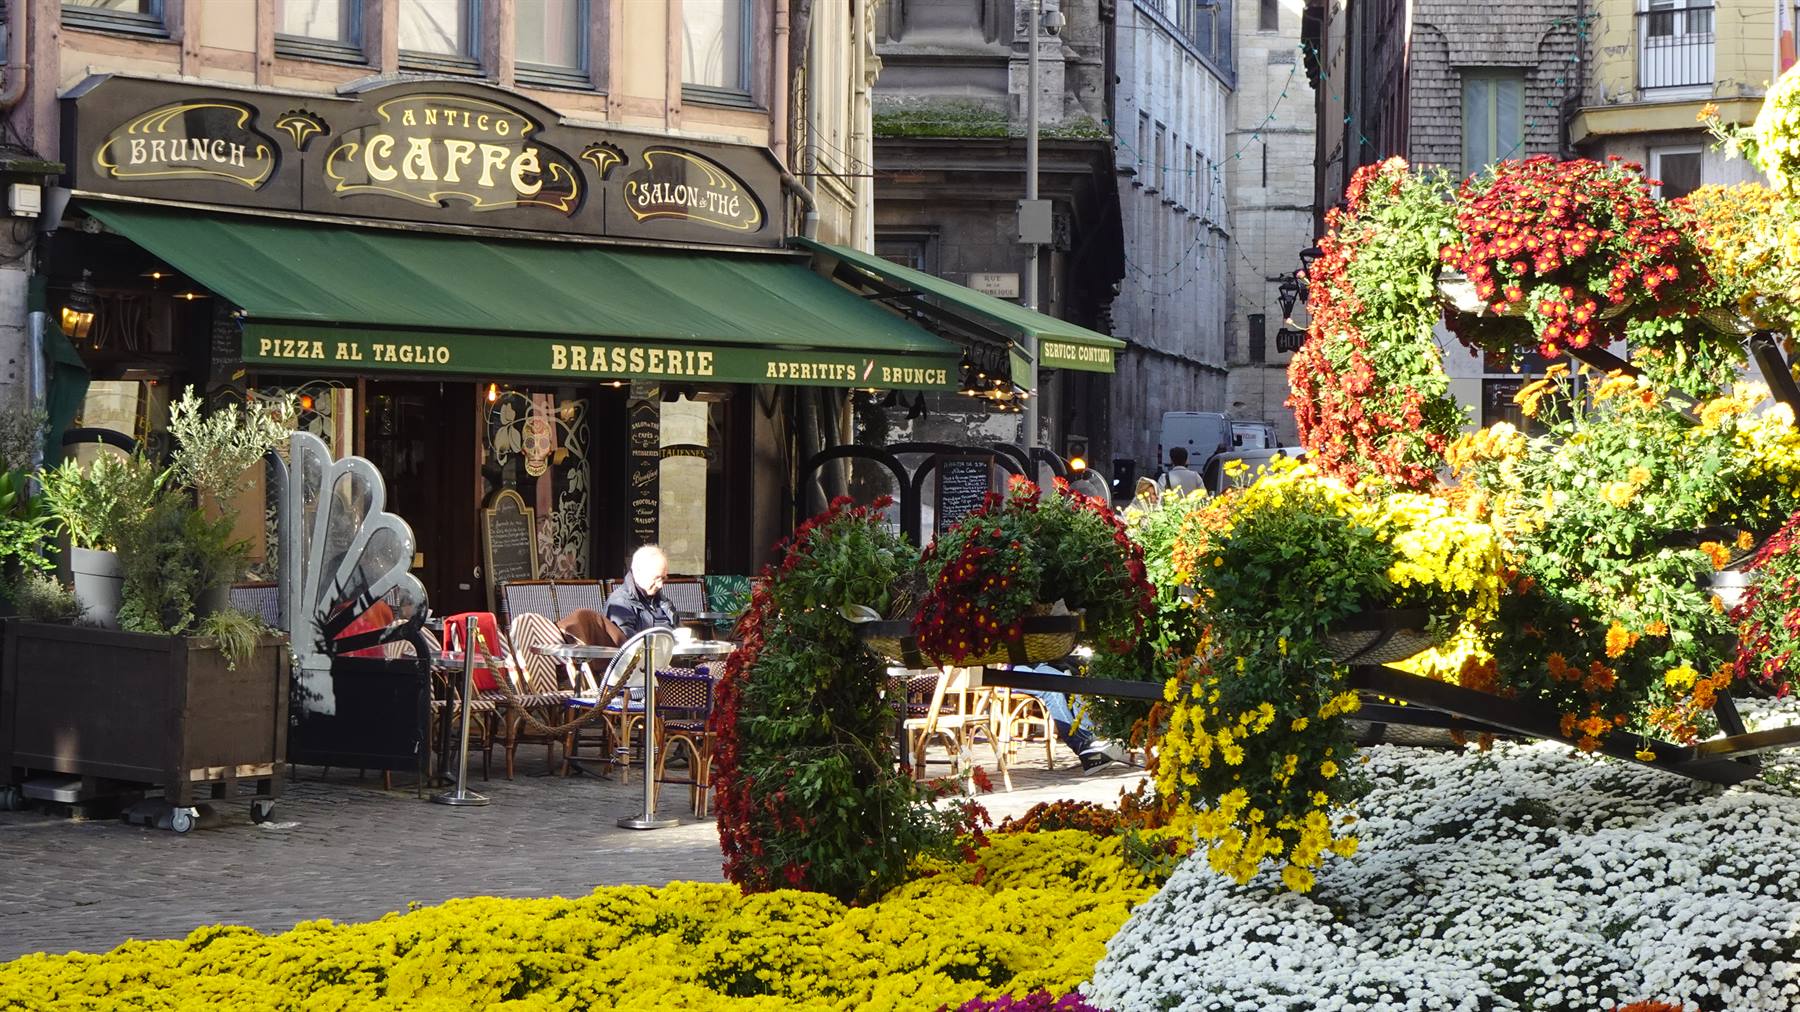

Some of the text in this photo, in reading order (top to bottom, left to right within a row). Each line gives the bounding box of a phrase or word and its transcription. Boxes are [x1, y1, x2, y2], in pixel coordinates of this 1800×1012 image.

[402, 108, 510, 136] ANTICO
[129, 138, 246, 168] BRUNCH
[638, 182, 700, 207] SALON
[259, 338, 325, 359] PIZZA
[335, 342, 363, 360] AL
[372, 344, 450, 364] TAGLIO
[551, 344, 713, 376] BRASSERIE
[1044, 342, 1110, 363] SERVICE CONTINU
[766, 362, 947, 385] APERITIFS BRUNCH
[632, 498, 658, 507] CHOCOLAT
